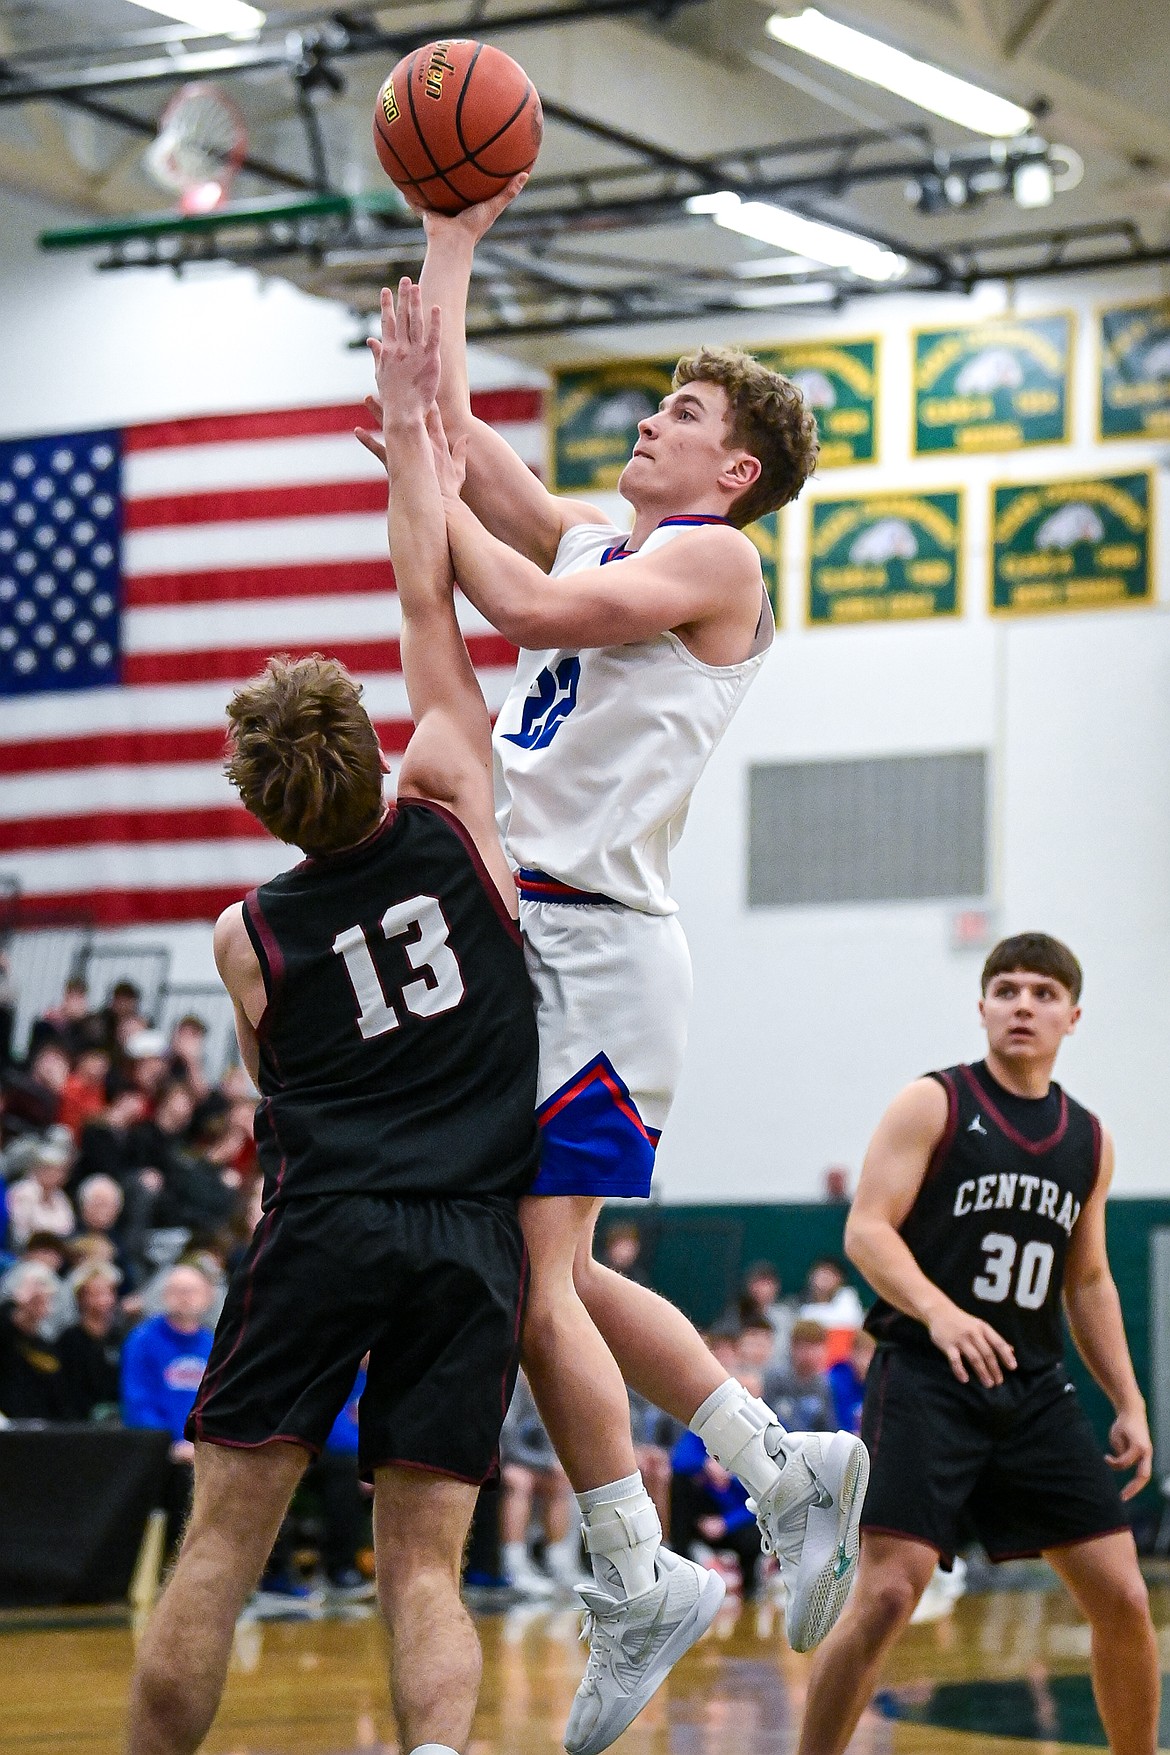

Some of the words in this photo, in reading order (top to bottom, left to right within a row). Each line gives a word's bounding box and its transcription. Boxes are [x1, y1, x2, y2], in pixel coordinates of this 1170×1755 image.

[425, 40, 463, 101] aden
[500, 656, 581, 751] 22
[332, 894, 465, 1040] 13
[972, 1232, 1055, 1311] 30
